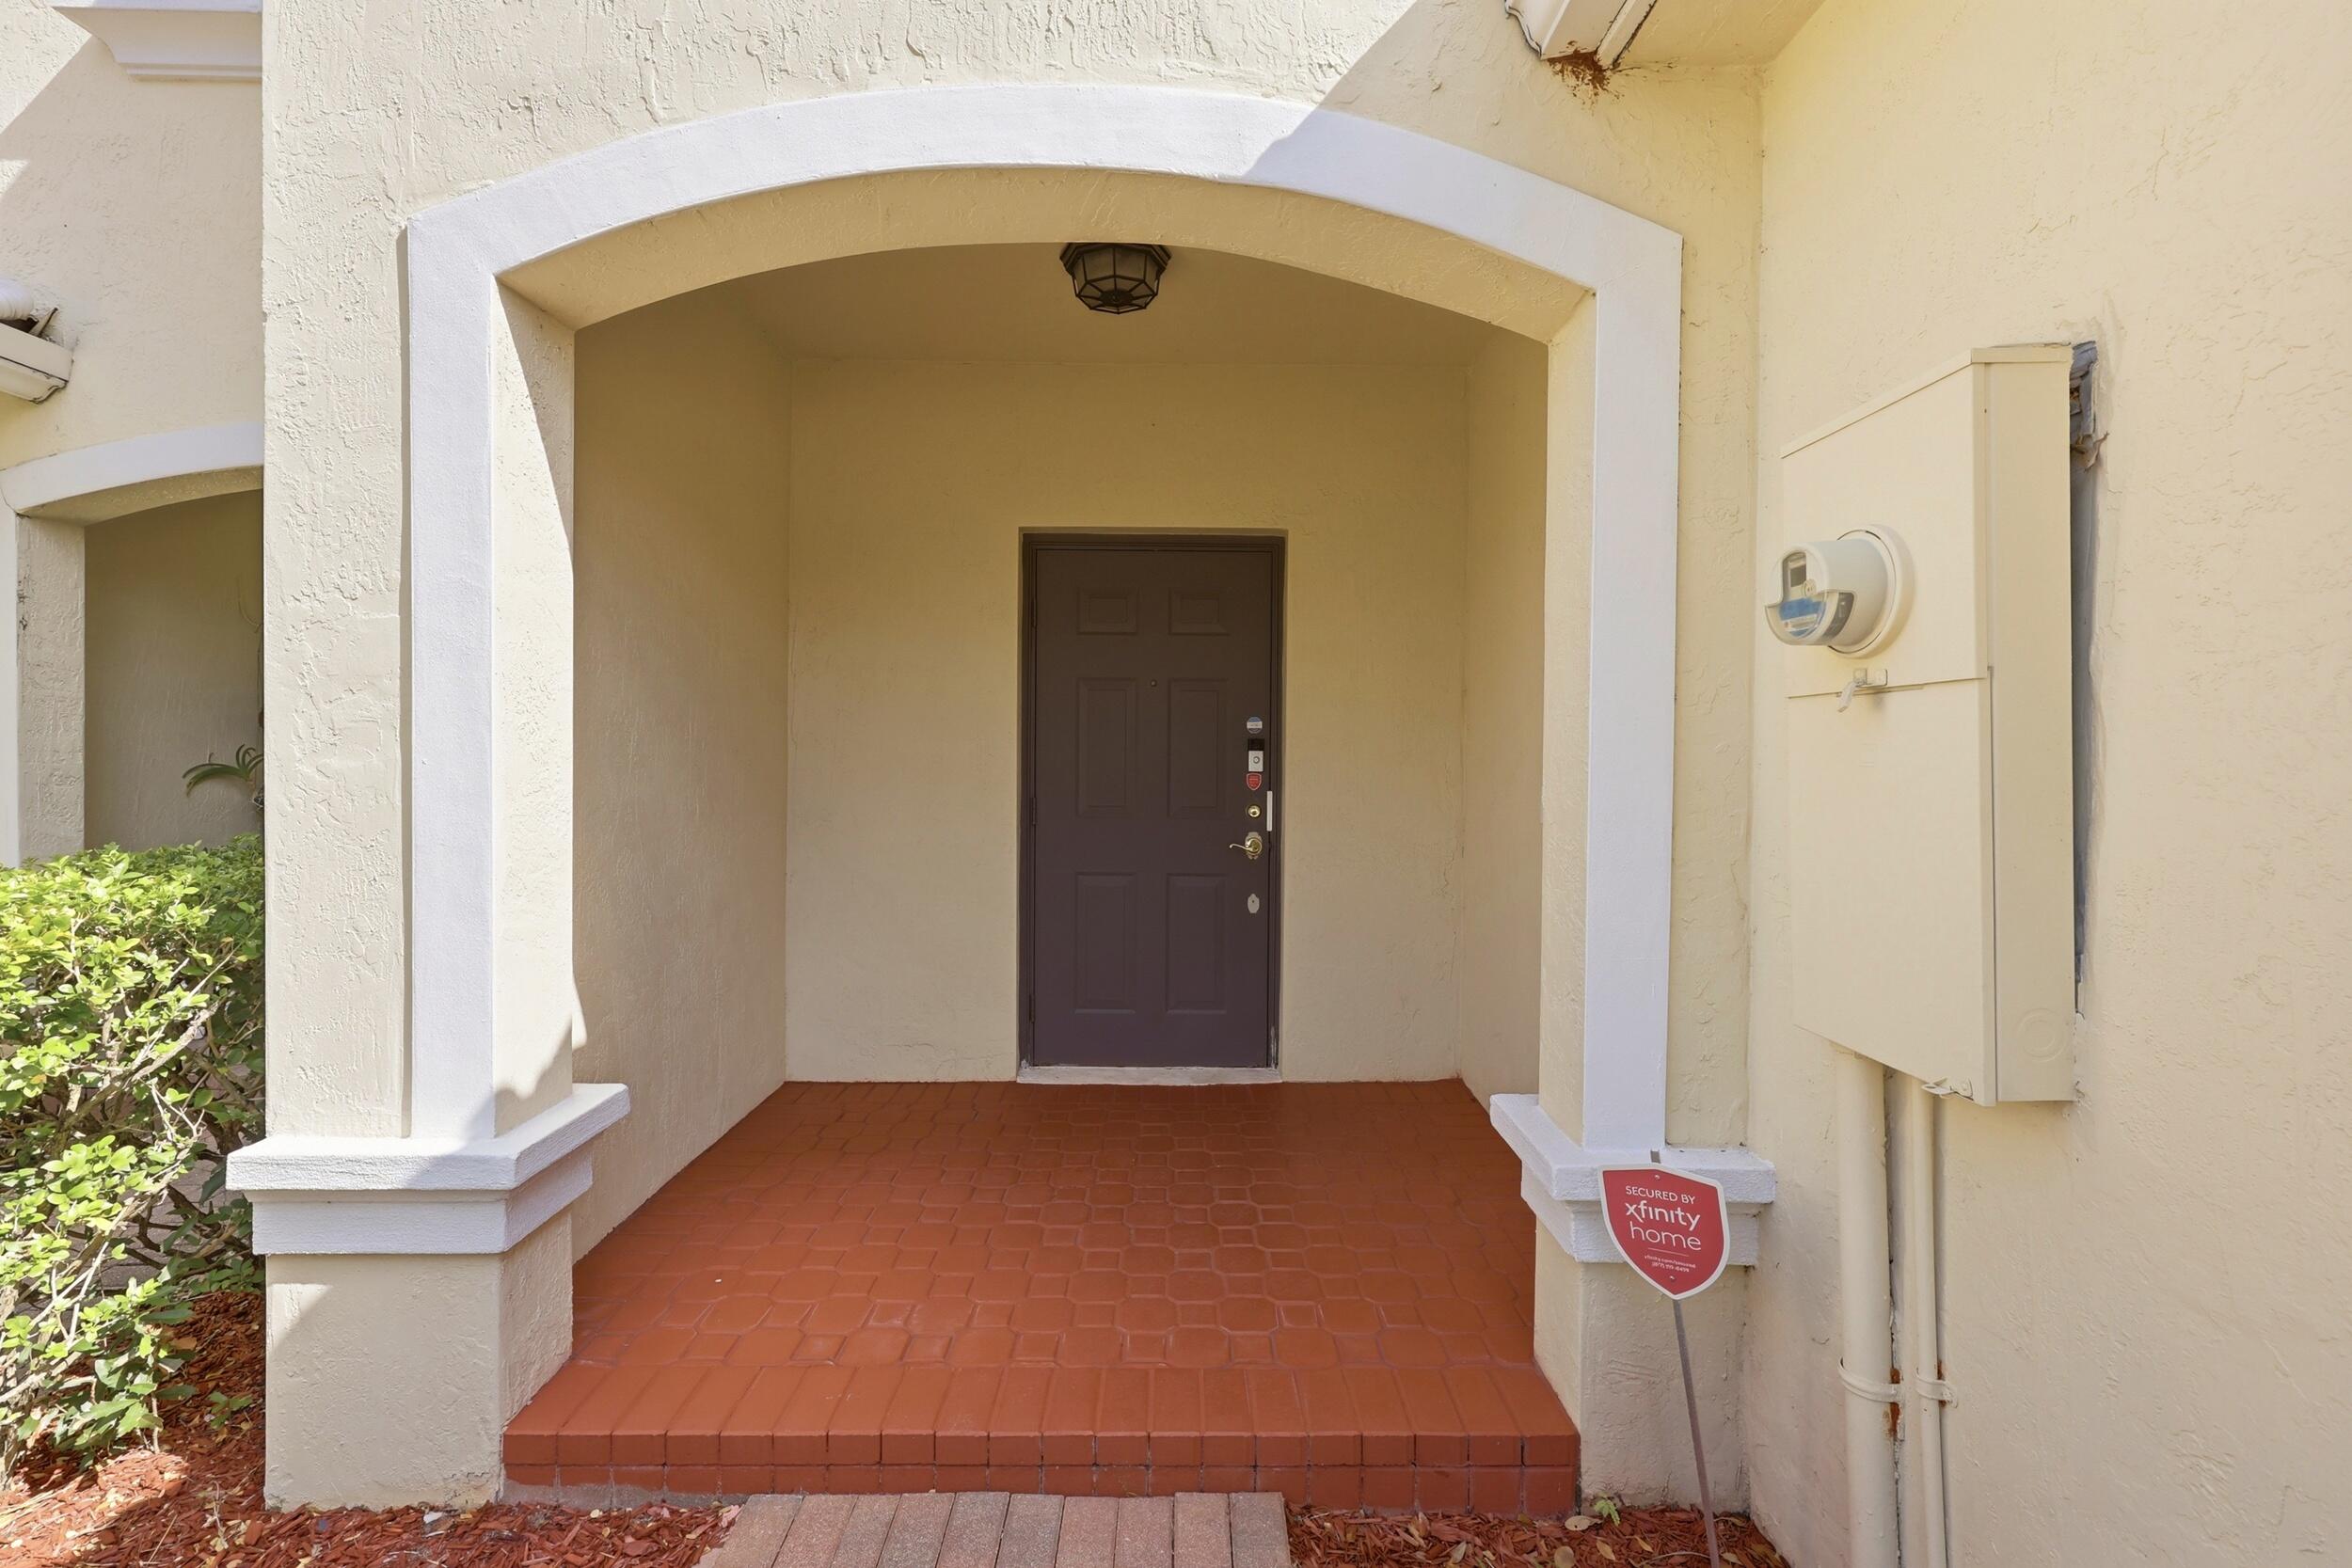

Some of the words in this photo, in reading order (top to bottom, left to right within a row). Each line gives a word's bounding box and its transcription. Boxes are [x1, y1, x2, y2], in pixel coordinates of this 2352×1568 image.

[1625, 1185, 1678, 1202] SECURED
[1681, 1194, 1696, 1205] BY
[1625, 1200, 1701, 1231] xfinity
[1629, 1221, 1702, 1251] home
